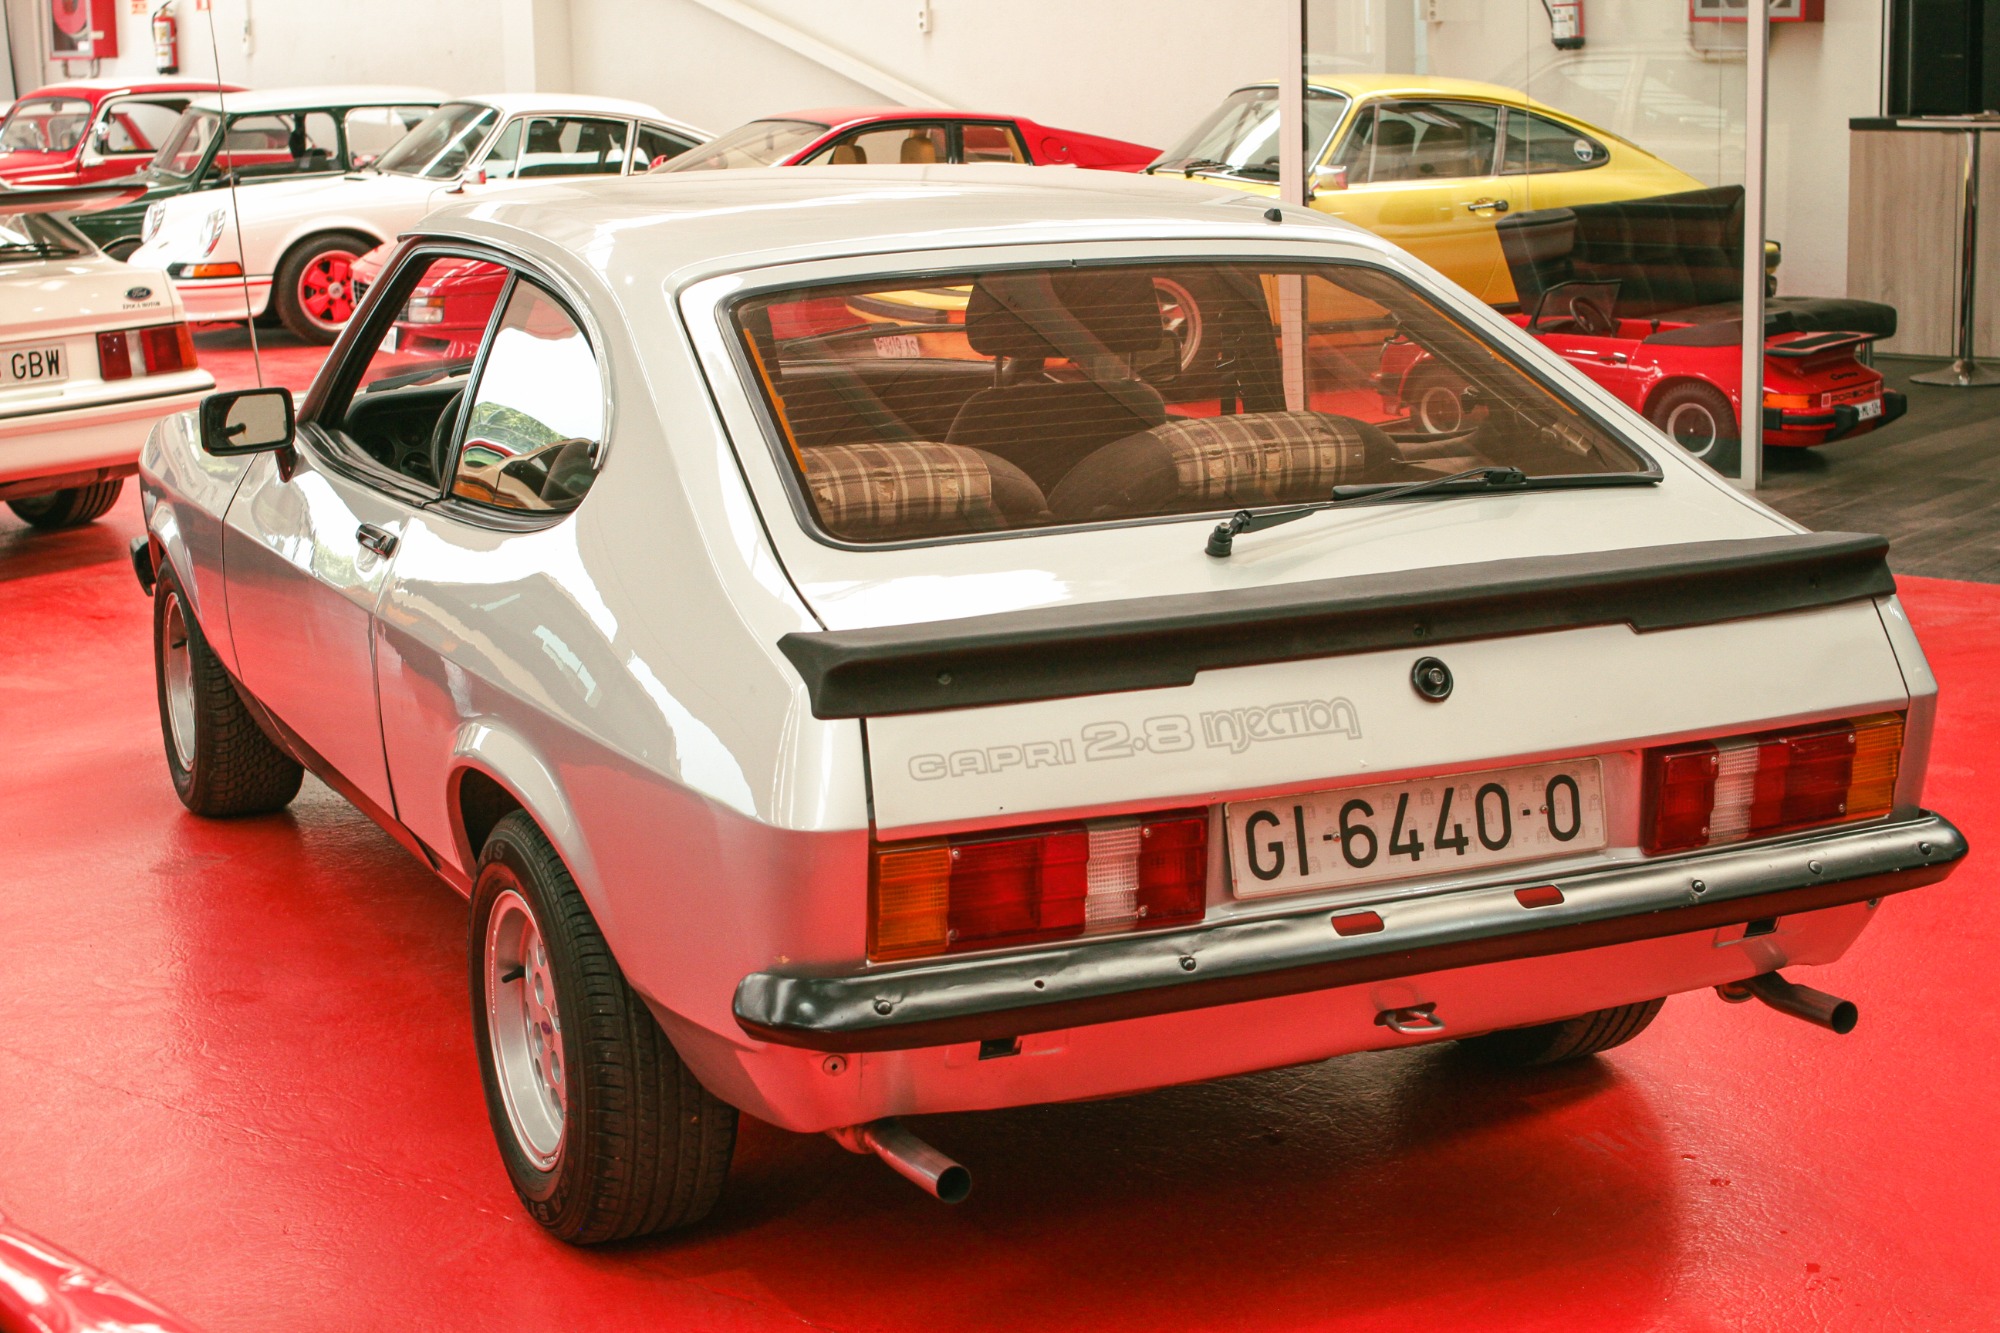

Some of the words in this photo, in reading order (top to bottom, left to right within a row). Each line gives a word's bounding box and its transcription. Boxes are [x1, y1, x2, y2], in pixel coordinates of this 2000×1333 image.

[11, 350, 59, 379] GBW
[1832, 386, 1874, 401] PORSCHE
[908, 739, 1076, 781] CAPRI
[1081, 714, 1194, 762] 2.8
